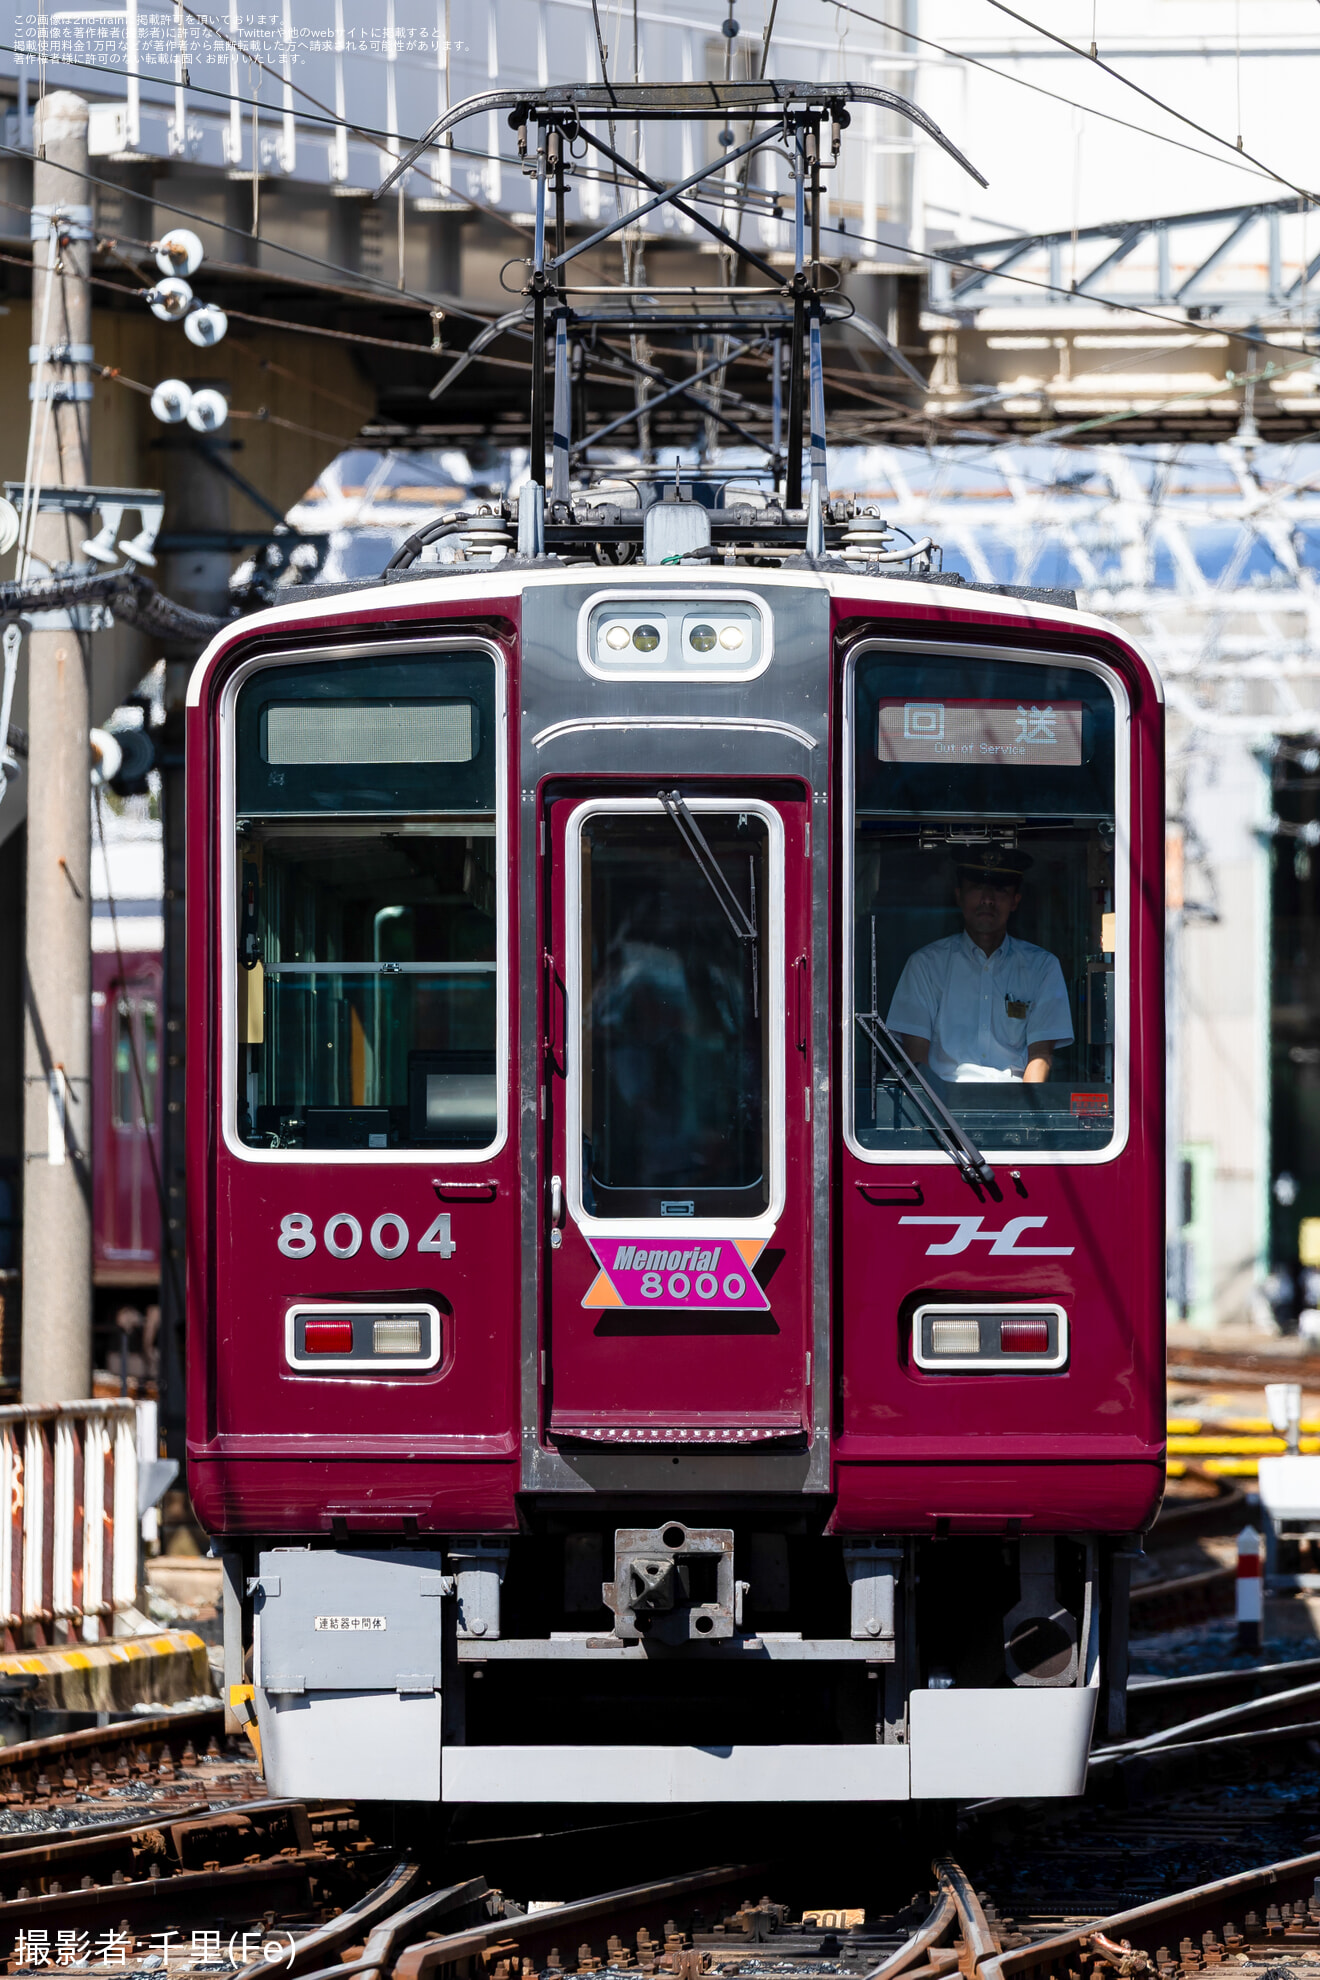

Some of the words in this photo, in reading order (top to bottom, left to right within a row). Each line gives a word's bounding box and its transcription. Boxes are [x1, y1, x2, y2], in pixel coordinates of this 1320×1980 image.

[935, 742, 956, 754] Out
[961, 742, 974, 754] of
[979, 742, 1026, 755] Service
[277, 1212, 456, 1259] 8004
[612, 1245, 722, 1272] Memorial
[640, 1272, 746, 1299] 8000
[319, 1617, 382, 1630] 連結器中間体
